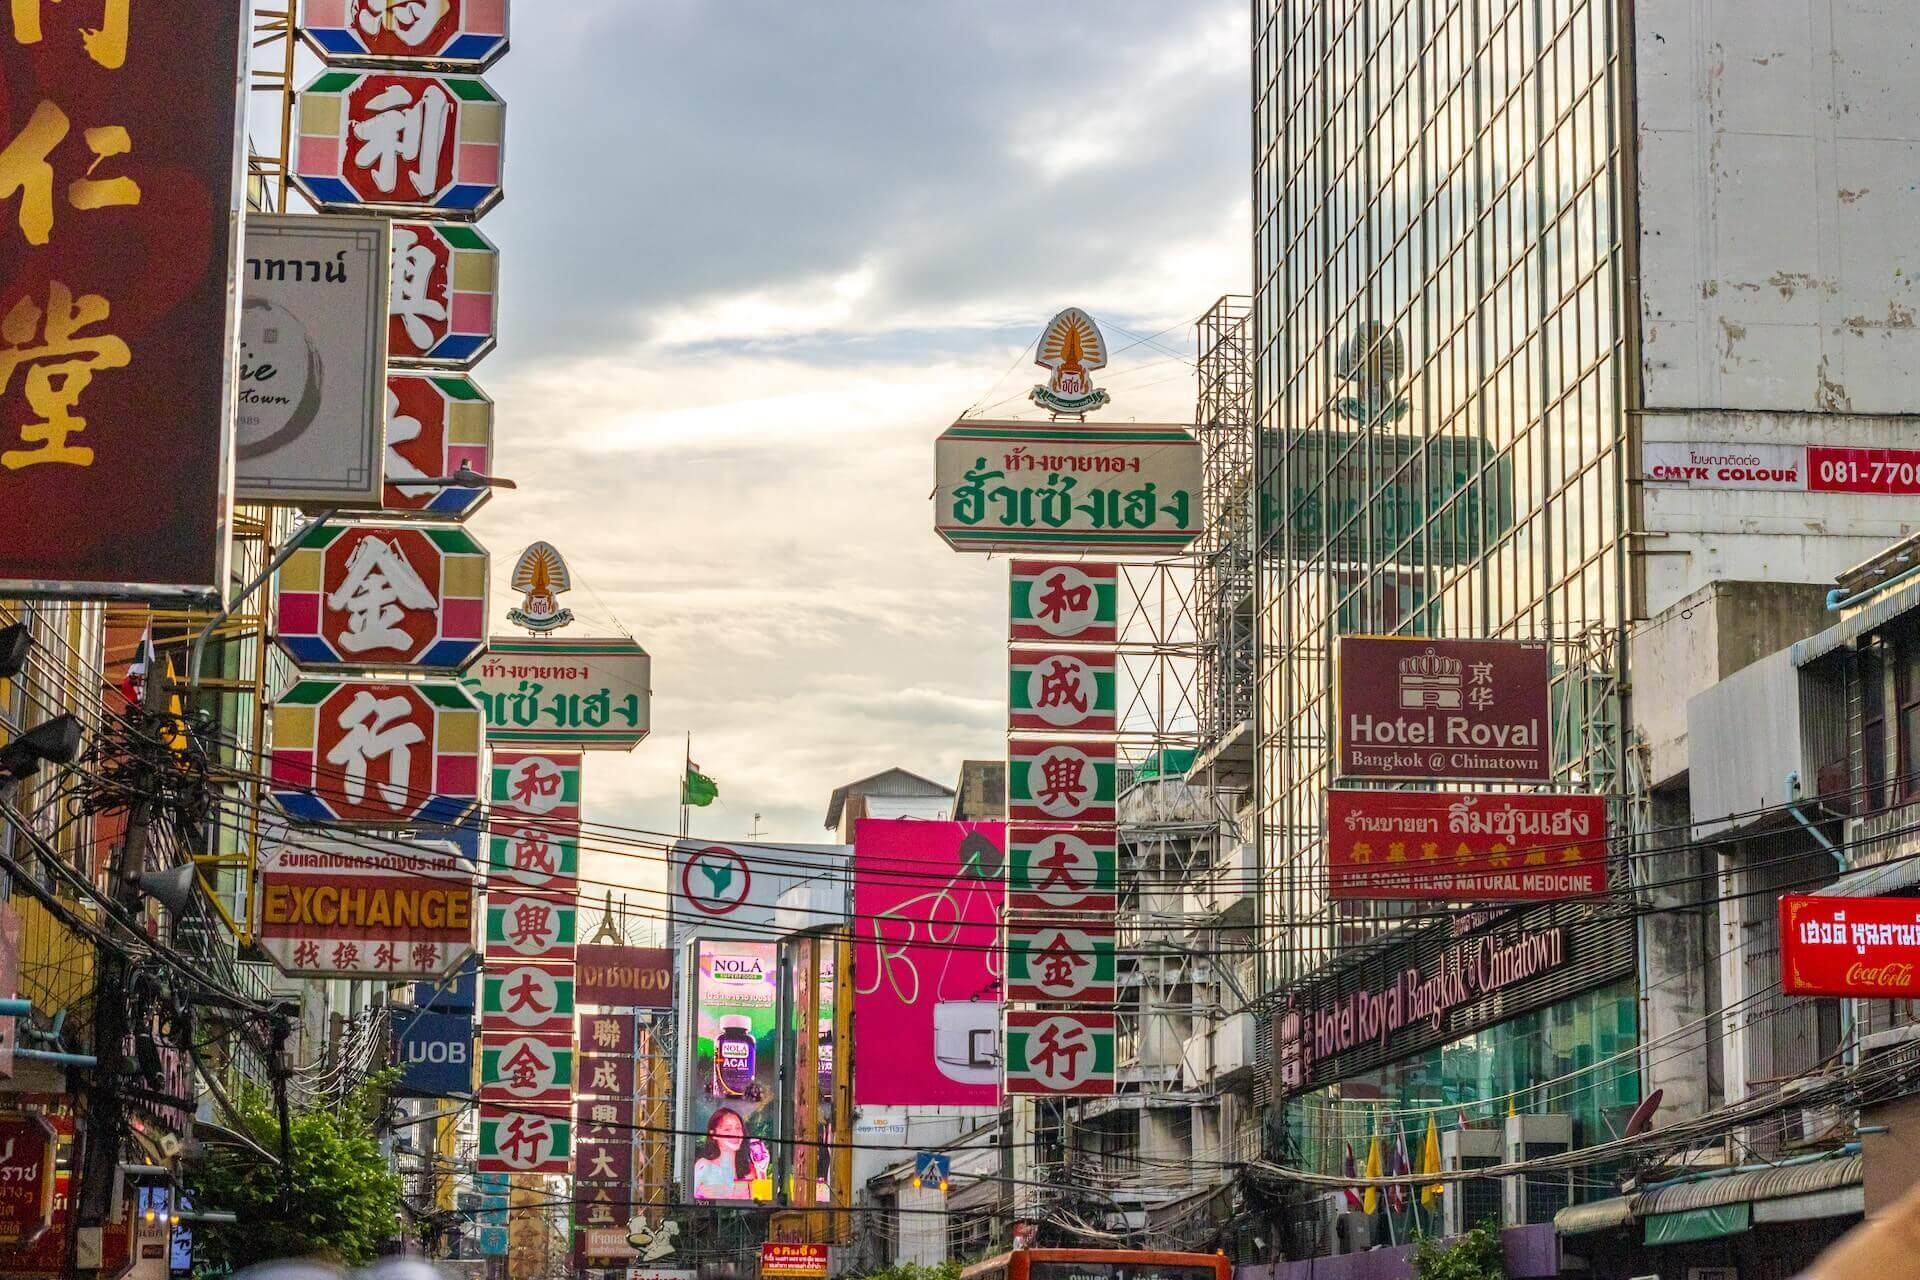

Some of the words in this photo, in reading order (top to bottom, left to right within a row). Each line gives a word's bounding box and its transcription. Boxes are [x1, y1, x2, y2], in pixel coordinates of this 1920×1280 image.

[246, 250, 347, 283] าทาวน์
[1003, 446, 1140, 473] ห้างขายทอง
[1653, 465, 1709, 481] CMYK
[1717, 467, 1797, 483] COLOUR
[952, 456, 1189, 530] ฮั่วเซ่งเฮง
[481, 657, 590, 680] ห้างขายทอง
[1468, 661, 1494, 711] 京华
[1351, 713, 1434, 745] Hotel
[1447, 716, 1538, 748] Royal
[1352, 752, 1423, 771] Bangkok
[1429, 752, 1446, 772] @
[1451, 753, 1538, 771] Chinatown
[1344, 809, 1438, 833] ร้านขายยา
[1414, 873, 1451, 890] HENG
[1456, 874, 1521, 891] NATURAL
[1523, 875, 1593, 892] MEDICINE
[266, 884, 469, 929] EXCHANGE
[293, 940, 441, 972] 找換外幣
[1846, 961, 1914, 987] Coca-Cola
[1315, 994, 1355, 1060] Hotel
[1359, 971, 1402, 1047] Royal
[1407, 946, 1467, 1031] Bangkok
[1478, 927, 1562, 993] Chinatown
[409, 1041, 466, 1064] UOB
